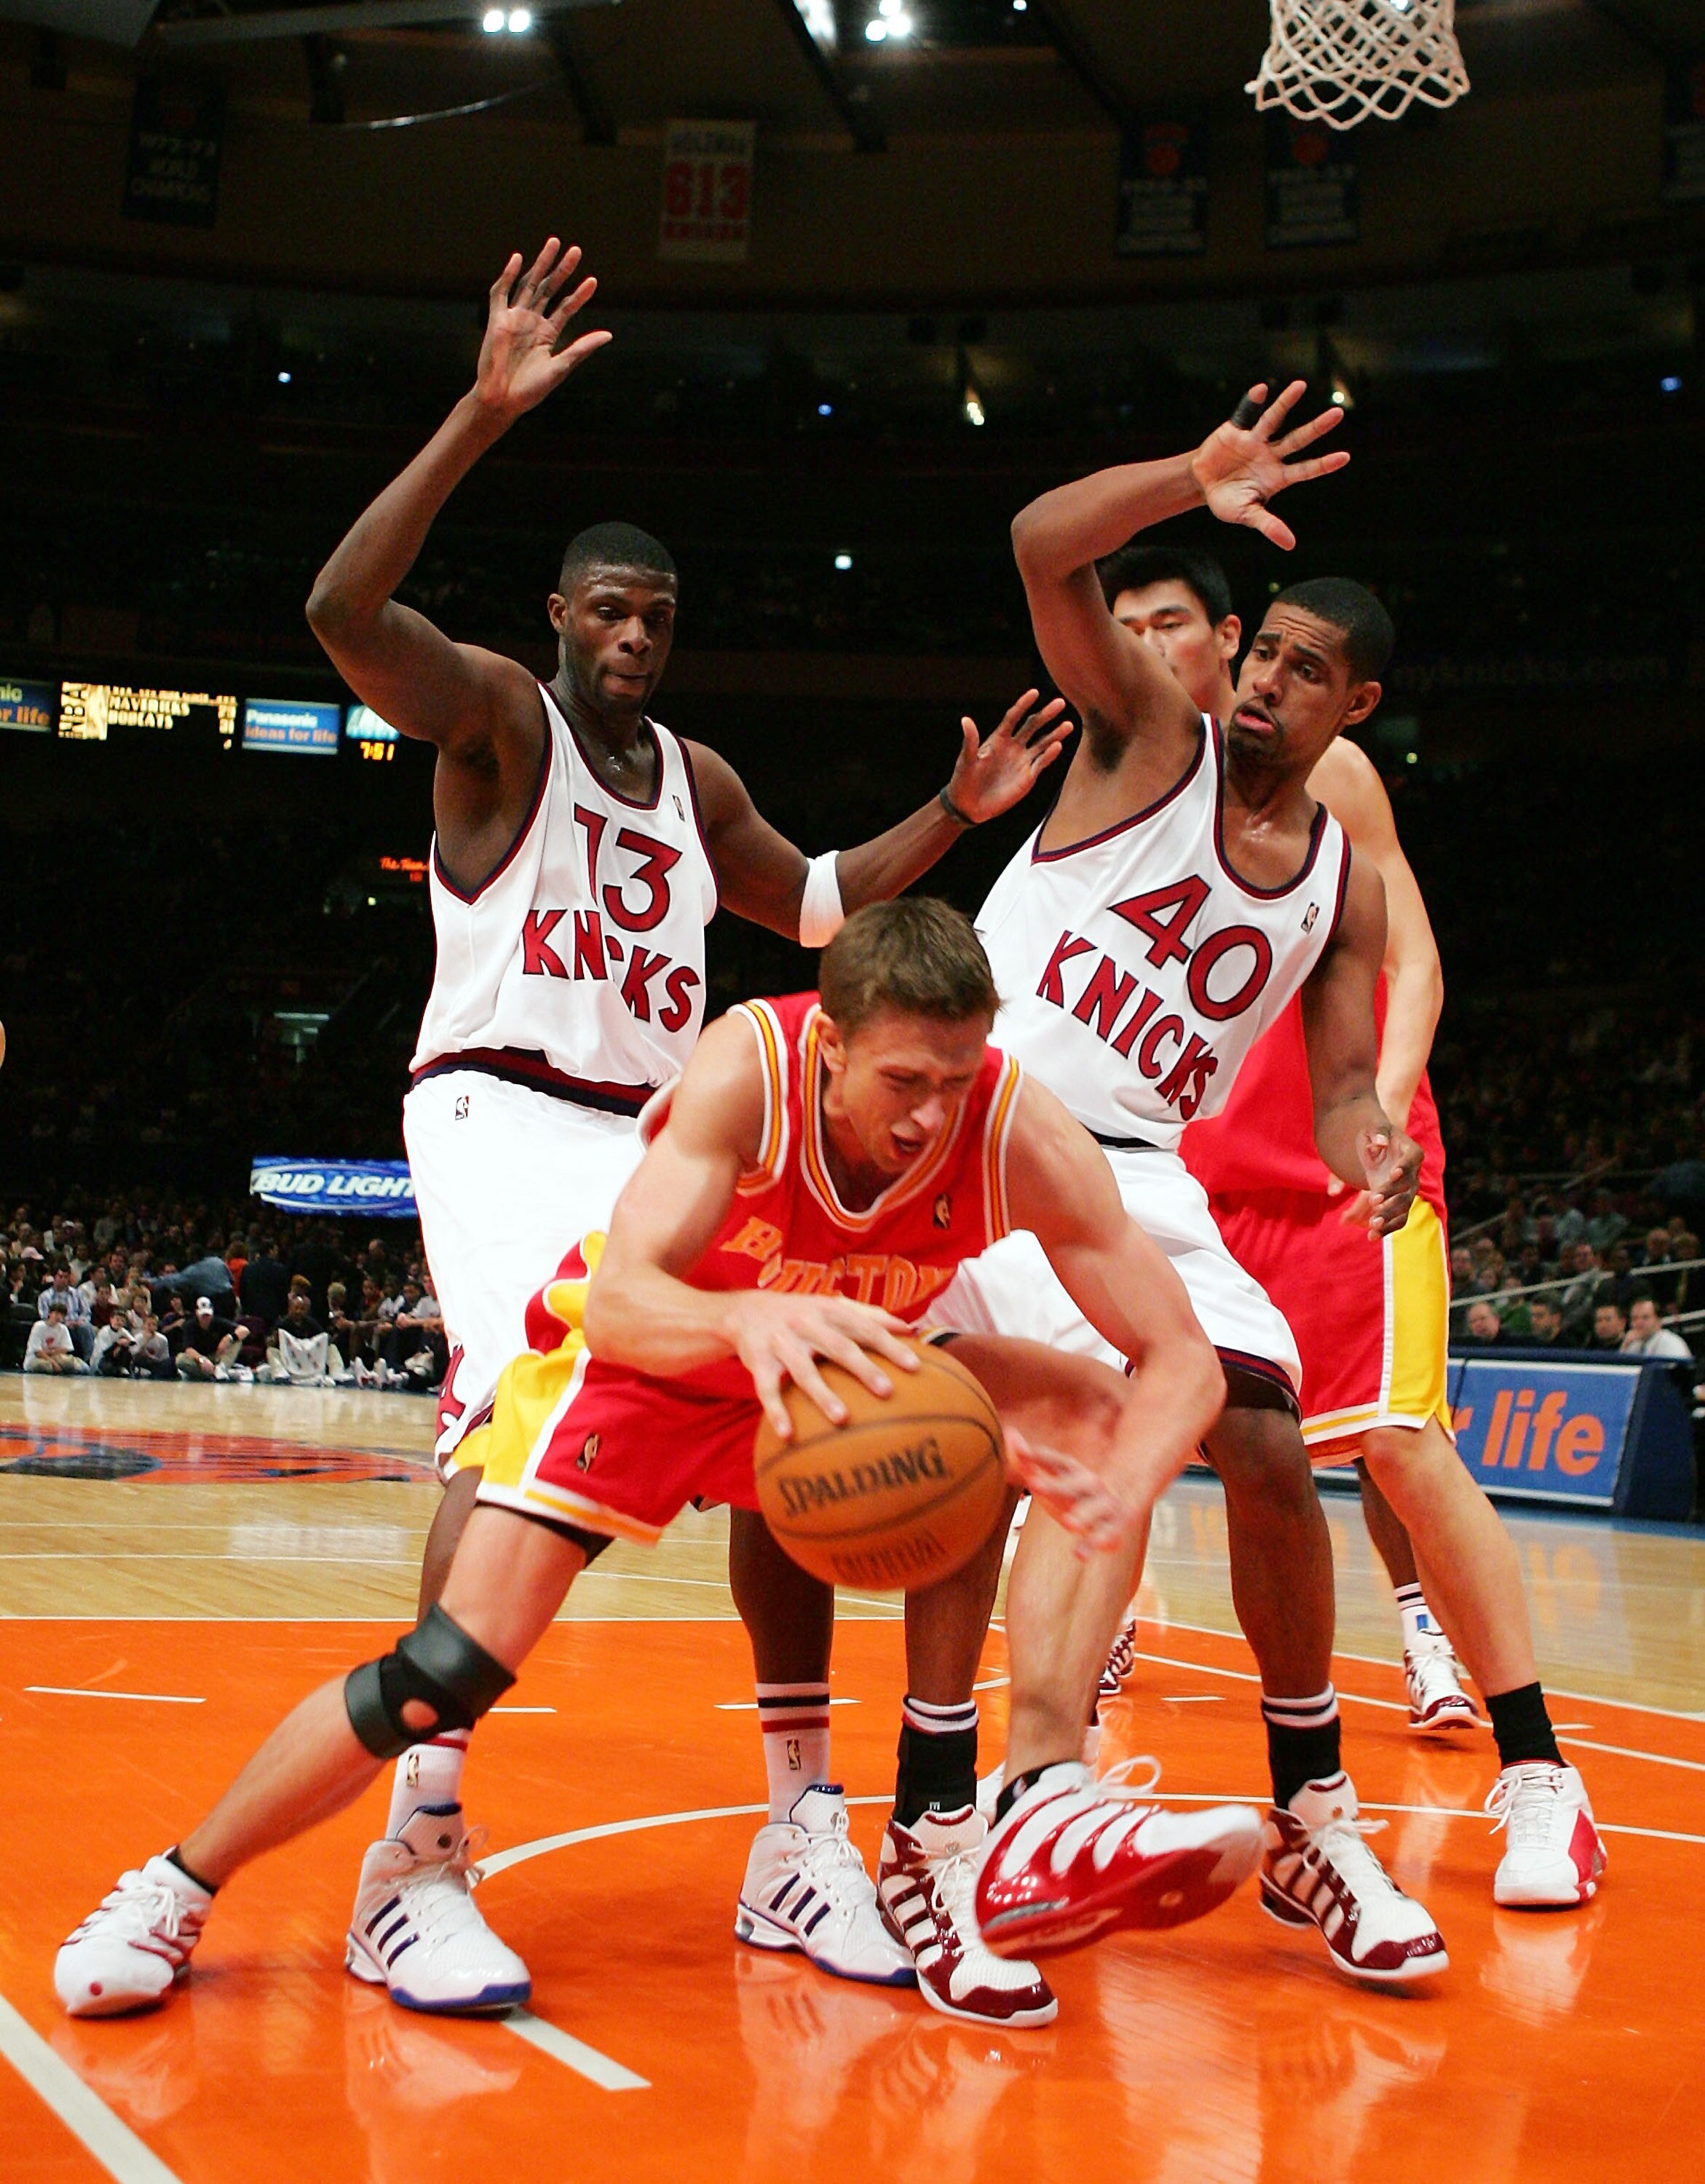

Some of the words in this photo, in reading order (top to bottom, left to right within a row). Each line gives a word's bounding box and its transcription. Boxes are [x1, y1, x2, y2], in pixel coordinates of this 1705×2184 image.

[666, 161, 748, 218] 613
[17, 705, 50, 725] life
[245, 726, 285, 740] ideas
[289, 728, 309, 741] for
[312, 729, 337, 743] life
[246, 709, 317, 728] Panasonic
[574, 802, 683, 933] 13
[522, 909, 700, 1033] KNKS
[1106, 874, 1273, 1021] 40
[1035, 930, 1218, 1121] KNICKS
[253, 1173, 325, 1195] BUD
[327, 1176, 415, 1198] LIGHT
[1482, 1389, 1605, 1476] life
[777, 1436, 946, 1518] SPALDING
